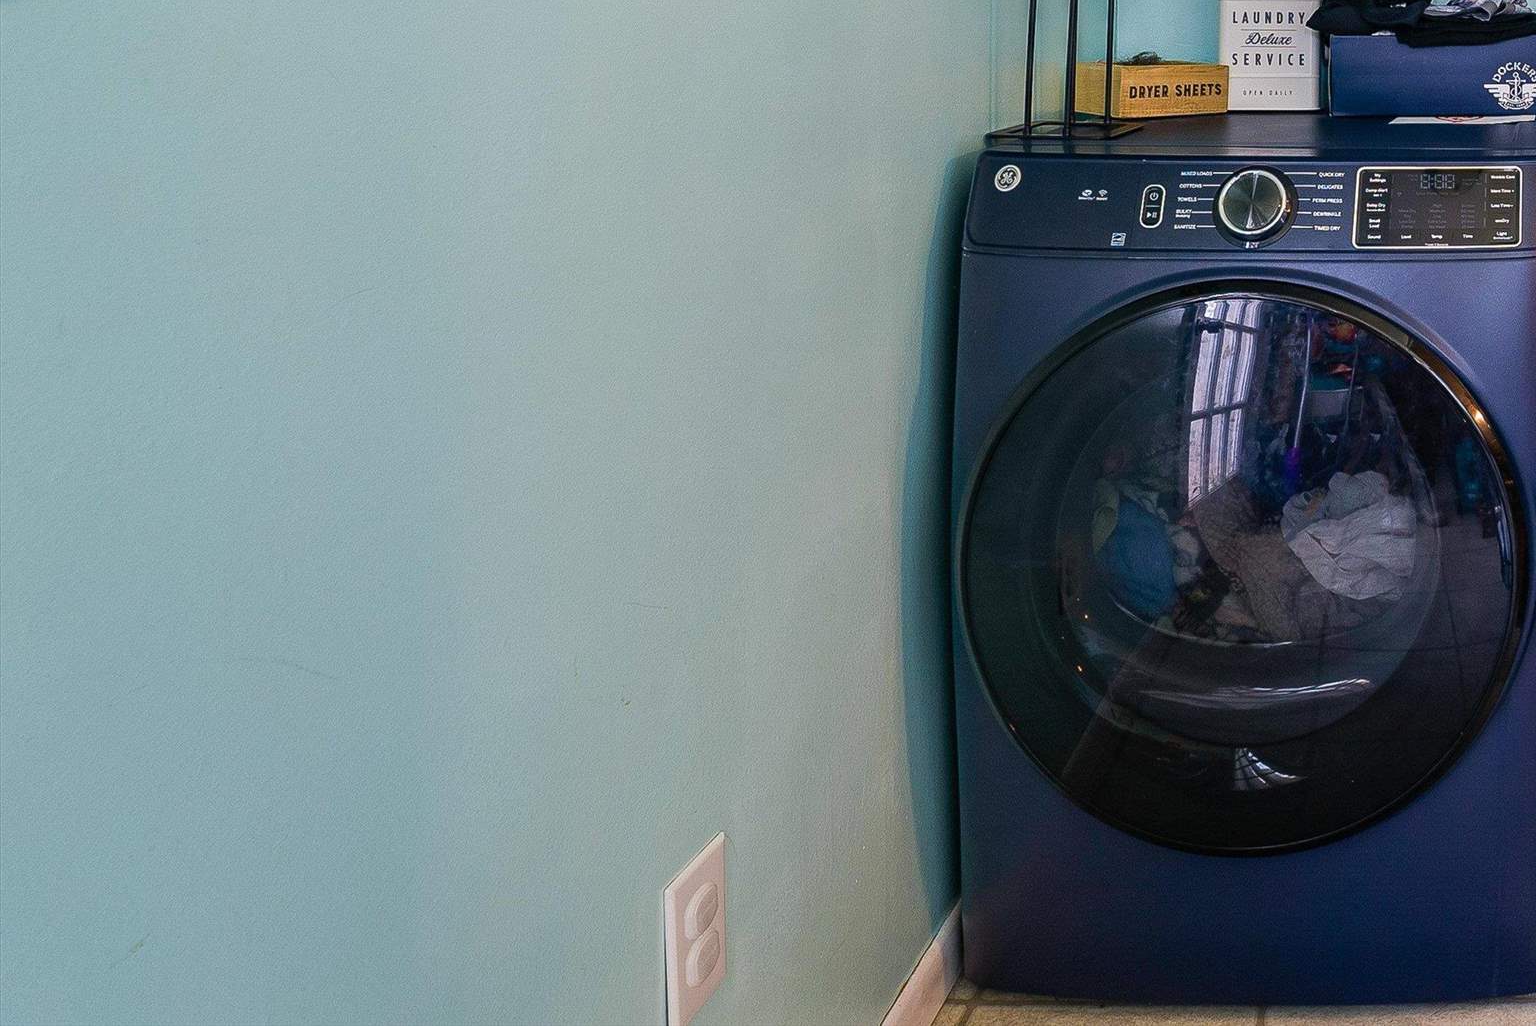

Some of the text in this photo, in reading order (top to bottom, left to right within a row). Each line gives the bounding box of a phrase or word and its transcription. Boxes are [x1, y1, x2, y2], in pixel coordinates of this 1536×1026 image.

[1232, 11, 1306, 24] LAUNDRY
[1244, 32, 1293, 45] Deluxe
[1232, 53, 1305, 66] SERVICE
[1129, 83, 1222, 99] DRYER SHEETS
